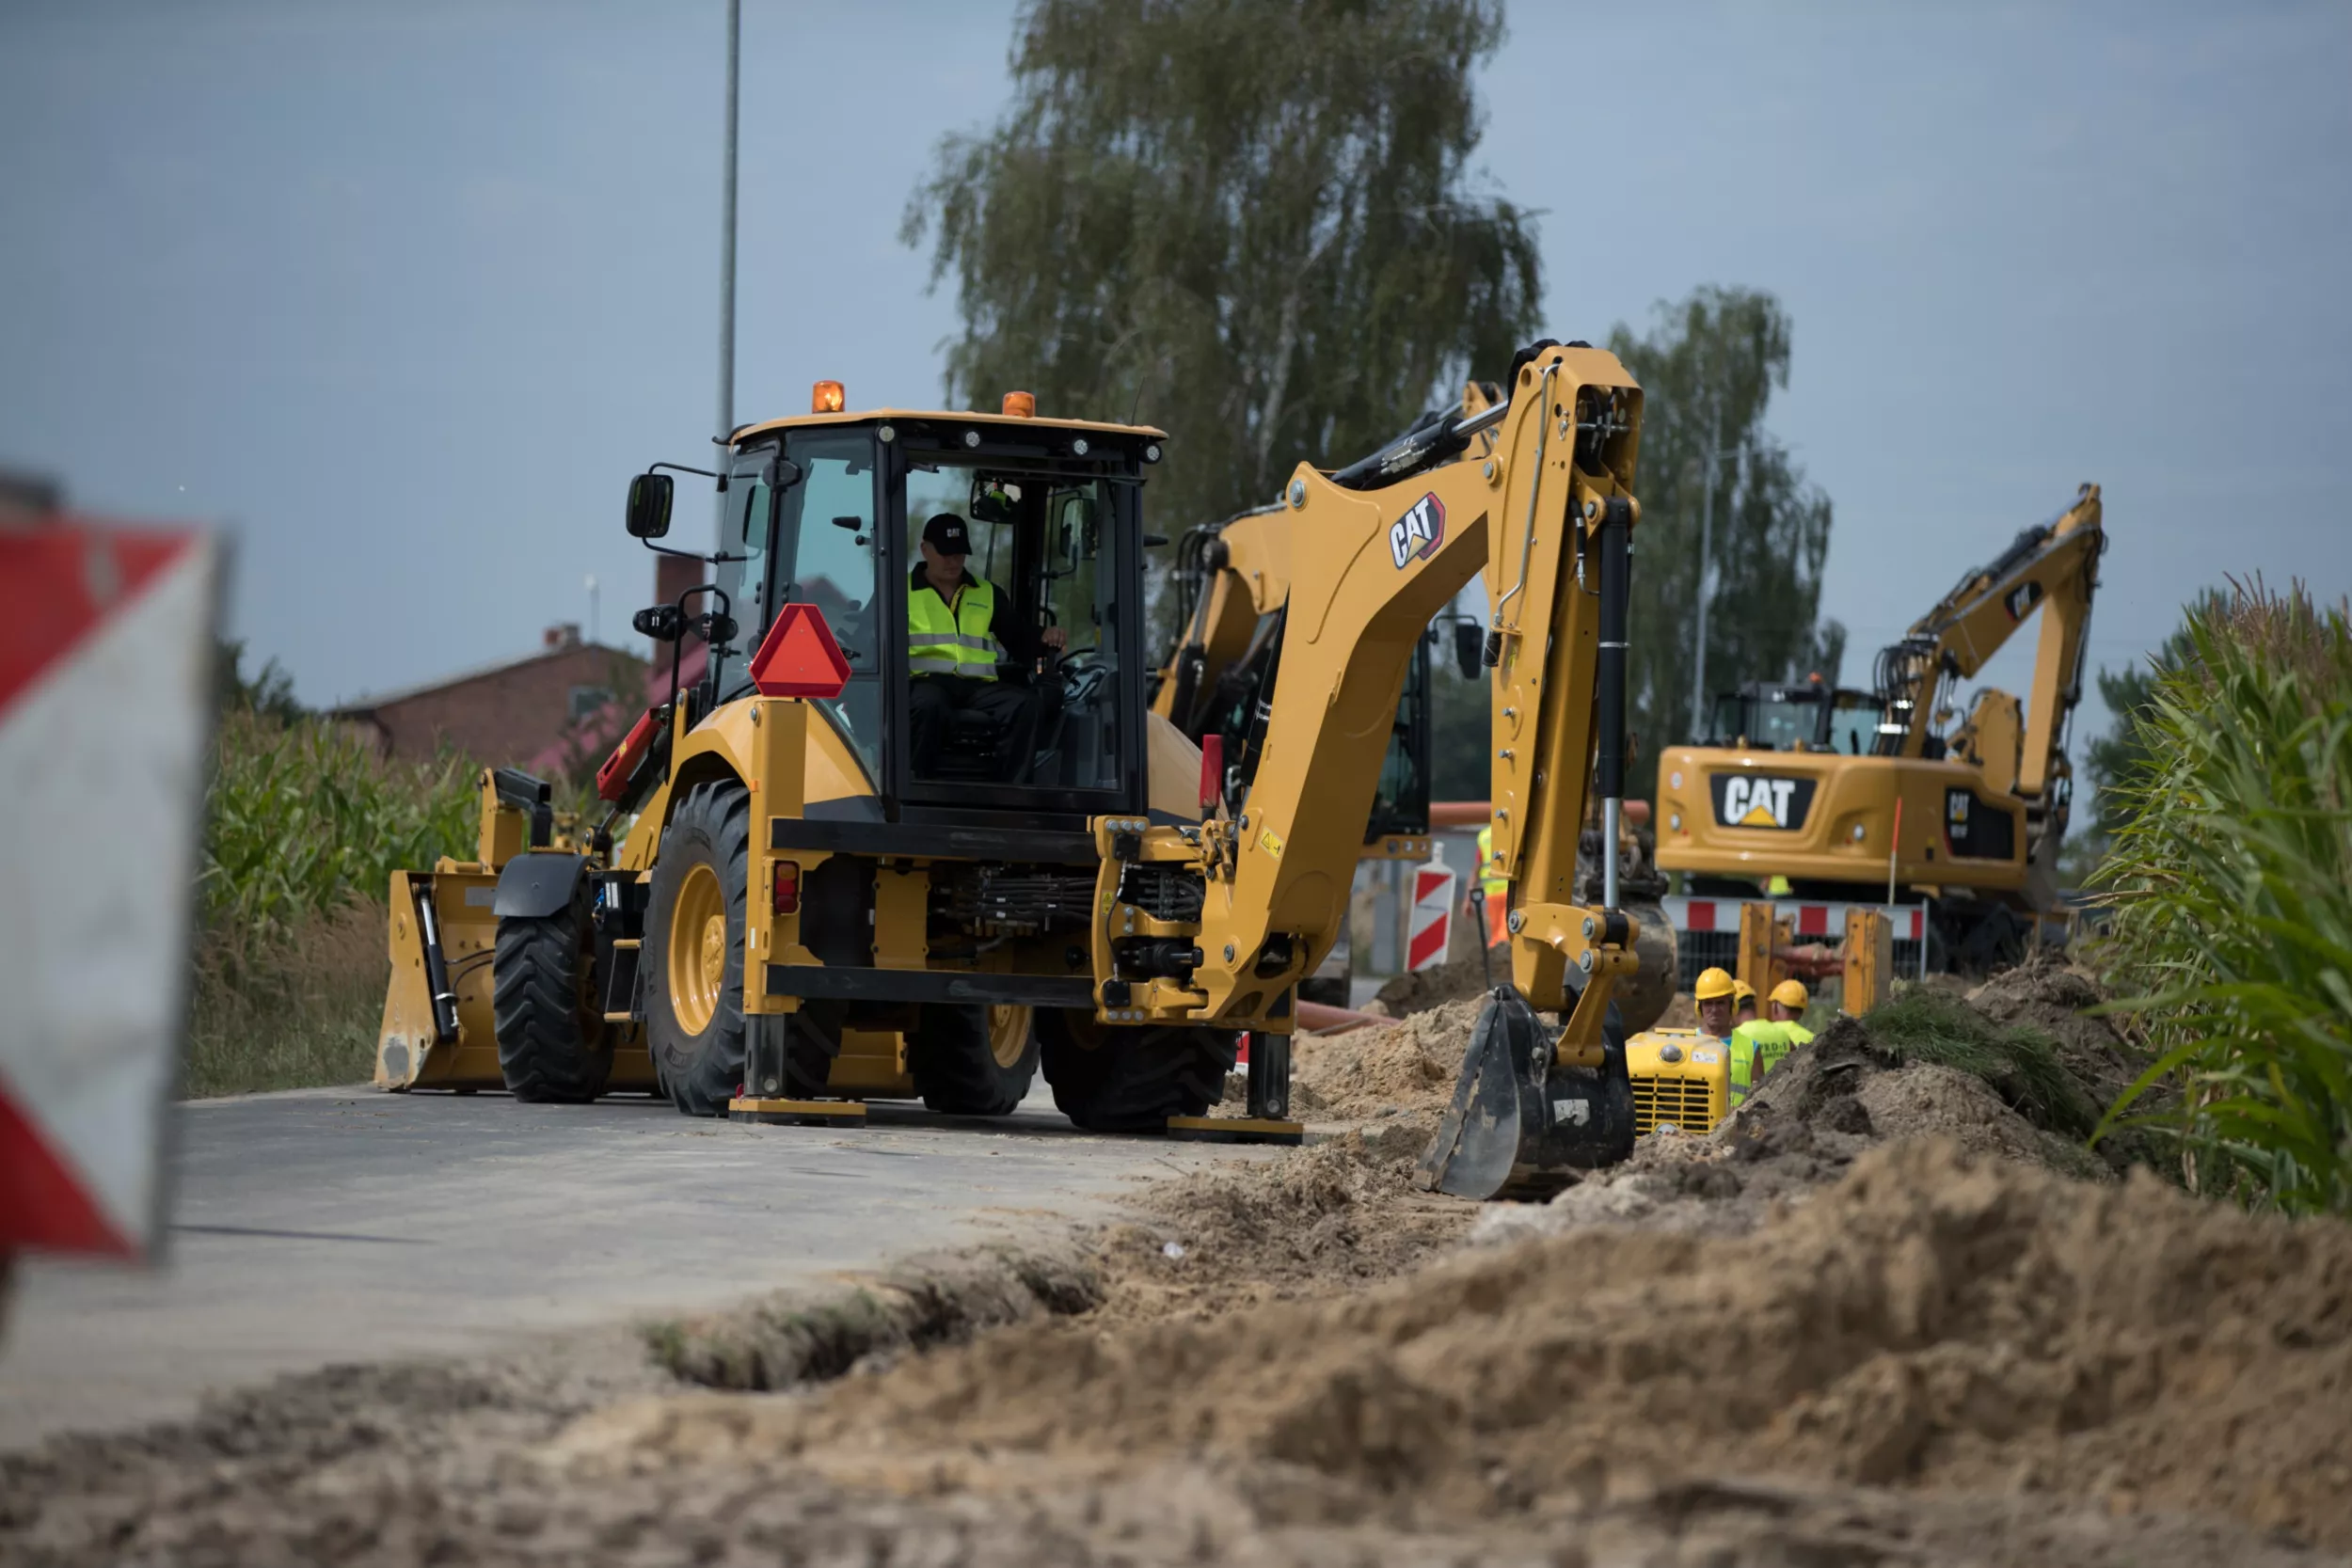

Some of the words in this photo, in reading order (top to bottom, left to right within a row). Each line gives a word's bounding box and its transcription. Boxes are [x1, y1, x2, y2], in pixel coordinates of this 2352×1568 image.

[946, 528, 960, 537] CAT
[1391, 497, 1432, 567] CAT
[1724, 776, 1795, 828] CAT
[1950, 792, 1969, 820] CAT
